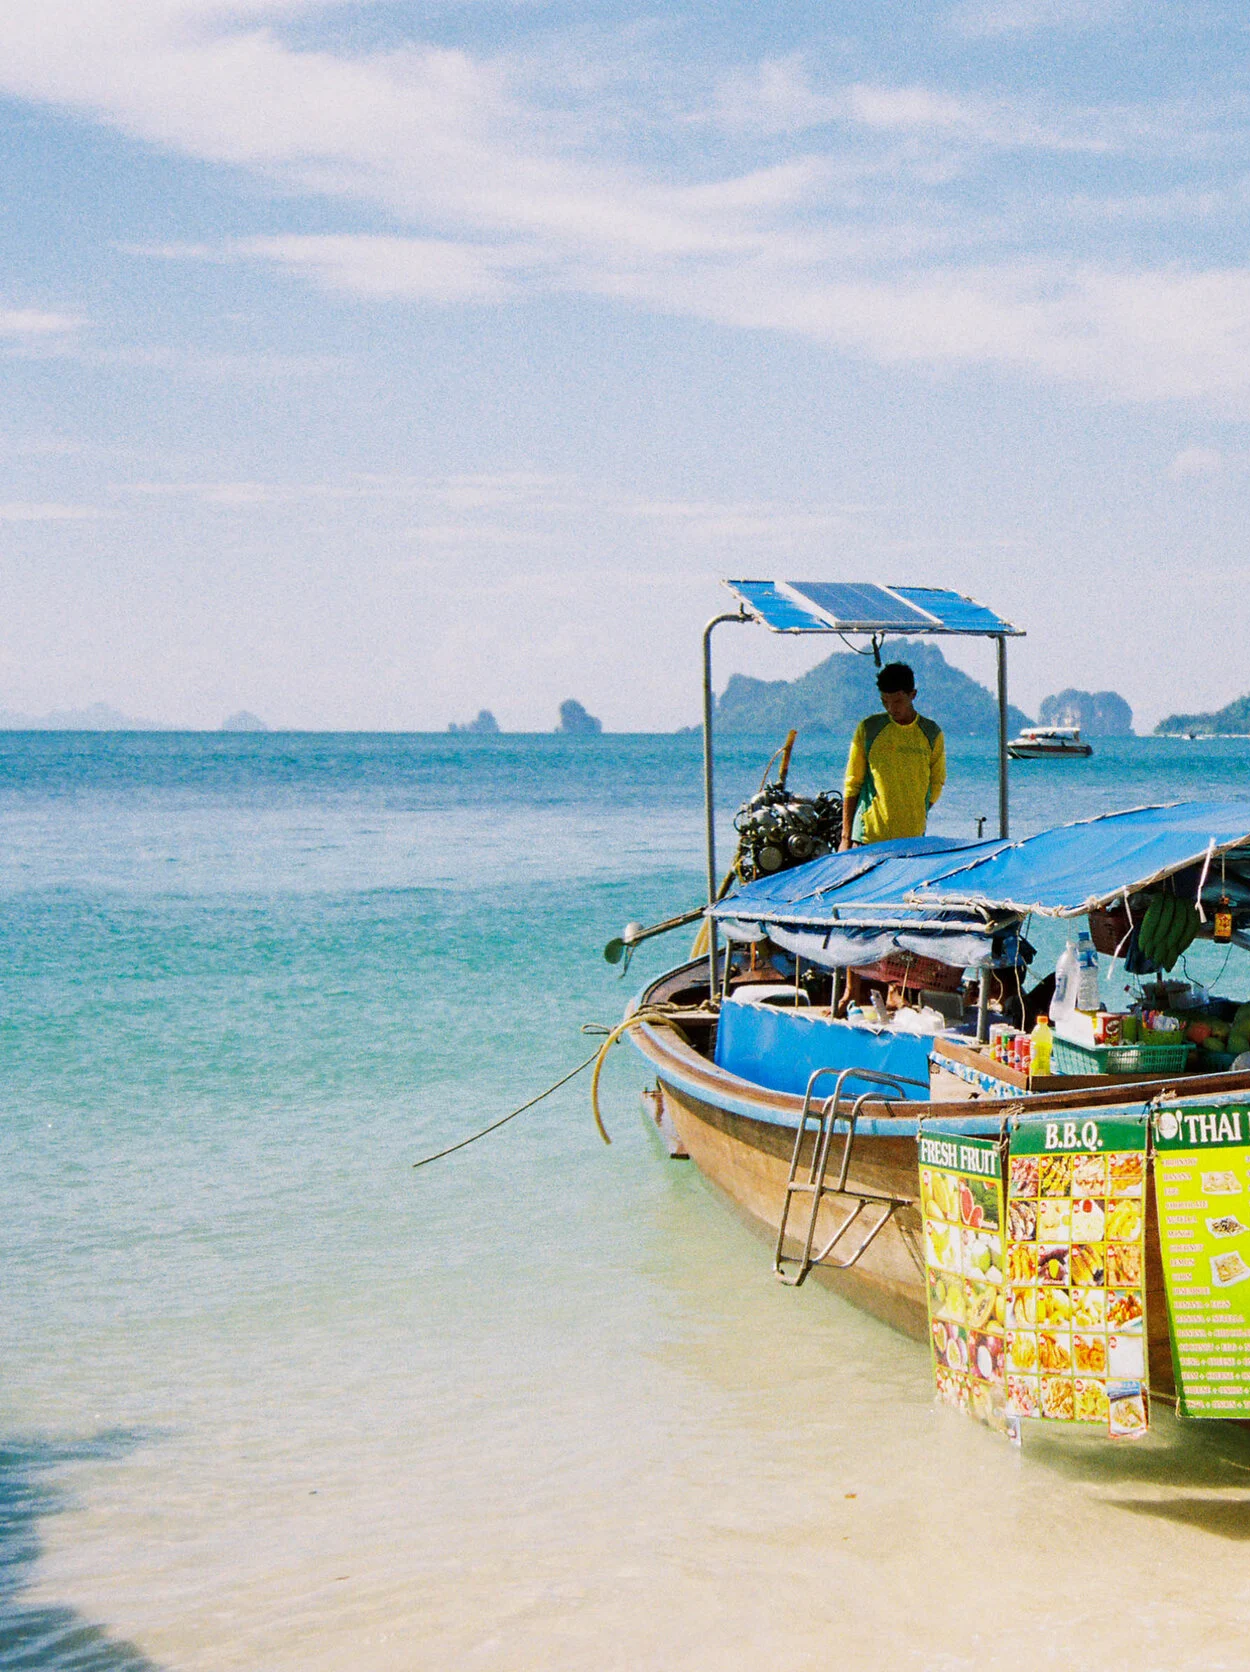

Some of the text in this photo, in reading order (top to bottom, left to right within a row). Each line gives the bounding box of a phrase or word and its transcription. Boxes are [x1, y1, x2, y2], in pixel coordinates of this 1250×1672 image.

[1045, 1121, 1104, 1152] B.B.Q.
[1184, 1111, 1242, 1144] THAI
[921, 1138, 997, 1175] FRESH FRUIT
